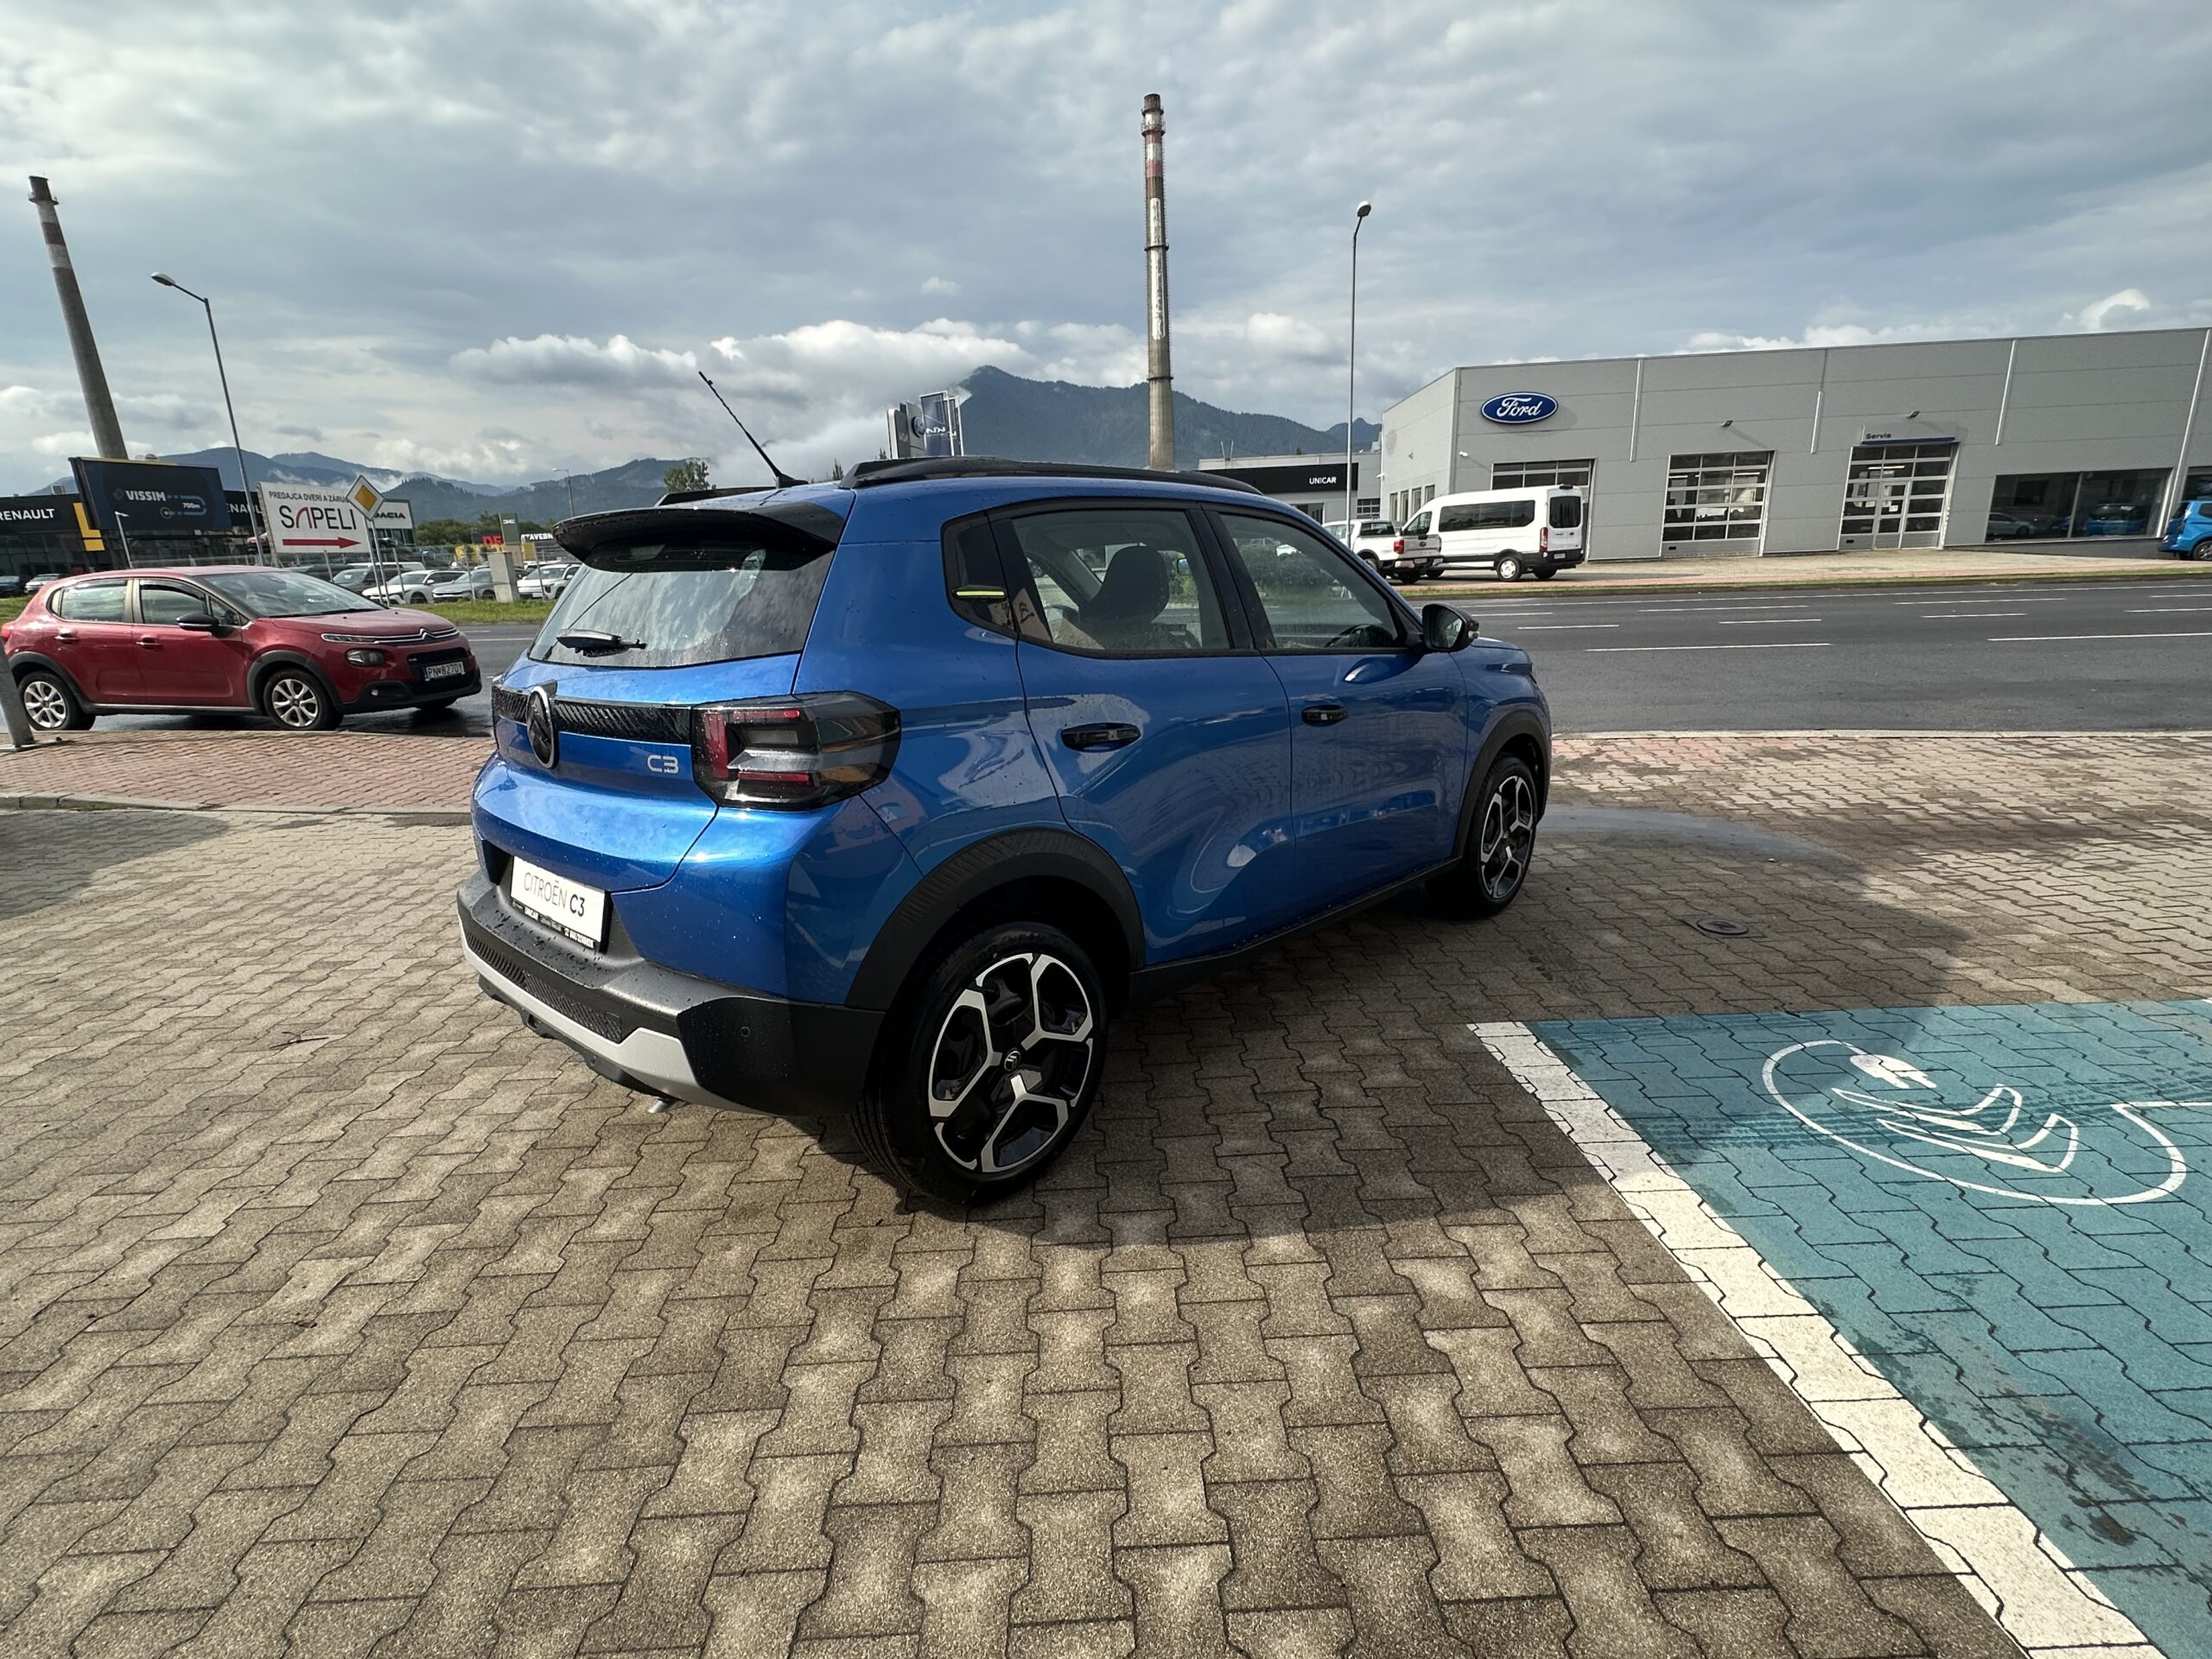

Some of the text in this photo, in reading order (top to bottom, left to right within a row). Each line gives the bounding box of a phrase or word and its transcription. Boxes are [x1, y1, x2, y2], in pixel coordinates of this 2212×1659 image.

[1496, 397, 1543, 416] Ford
[1308, 476, 1338, 485] UNICAR
[124, 490, 167, 501] VISSIM
[269, 491, 303, 500] PREDAJCA
[279, 505, 357, 530] SAPELI
[647, 754, 679, 774] C3
[524, 872, 568, 910] CITROËN
[569, 893, 586, 918] C3
